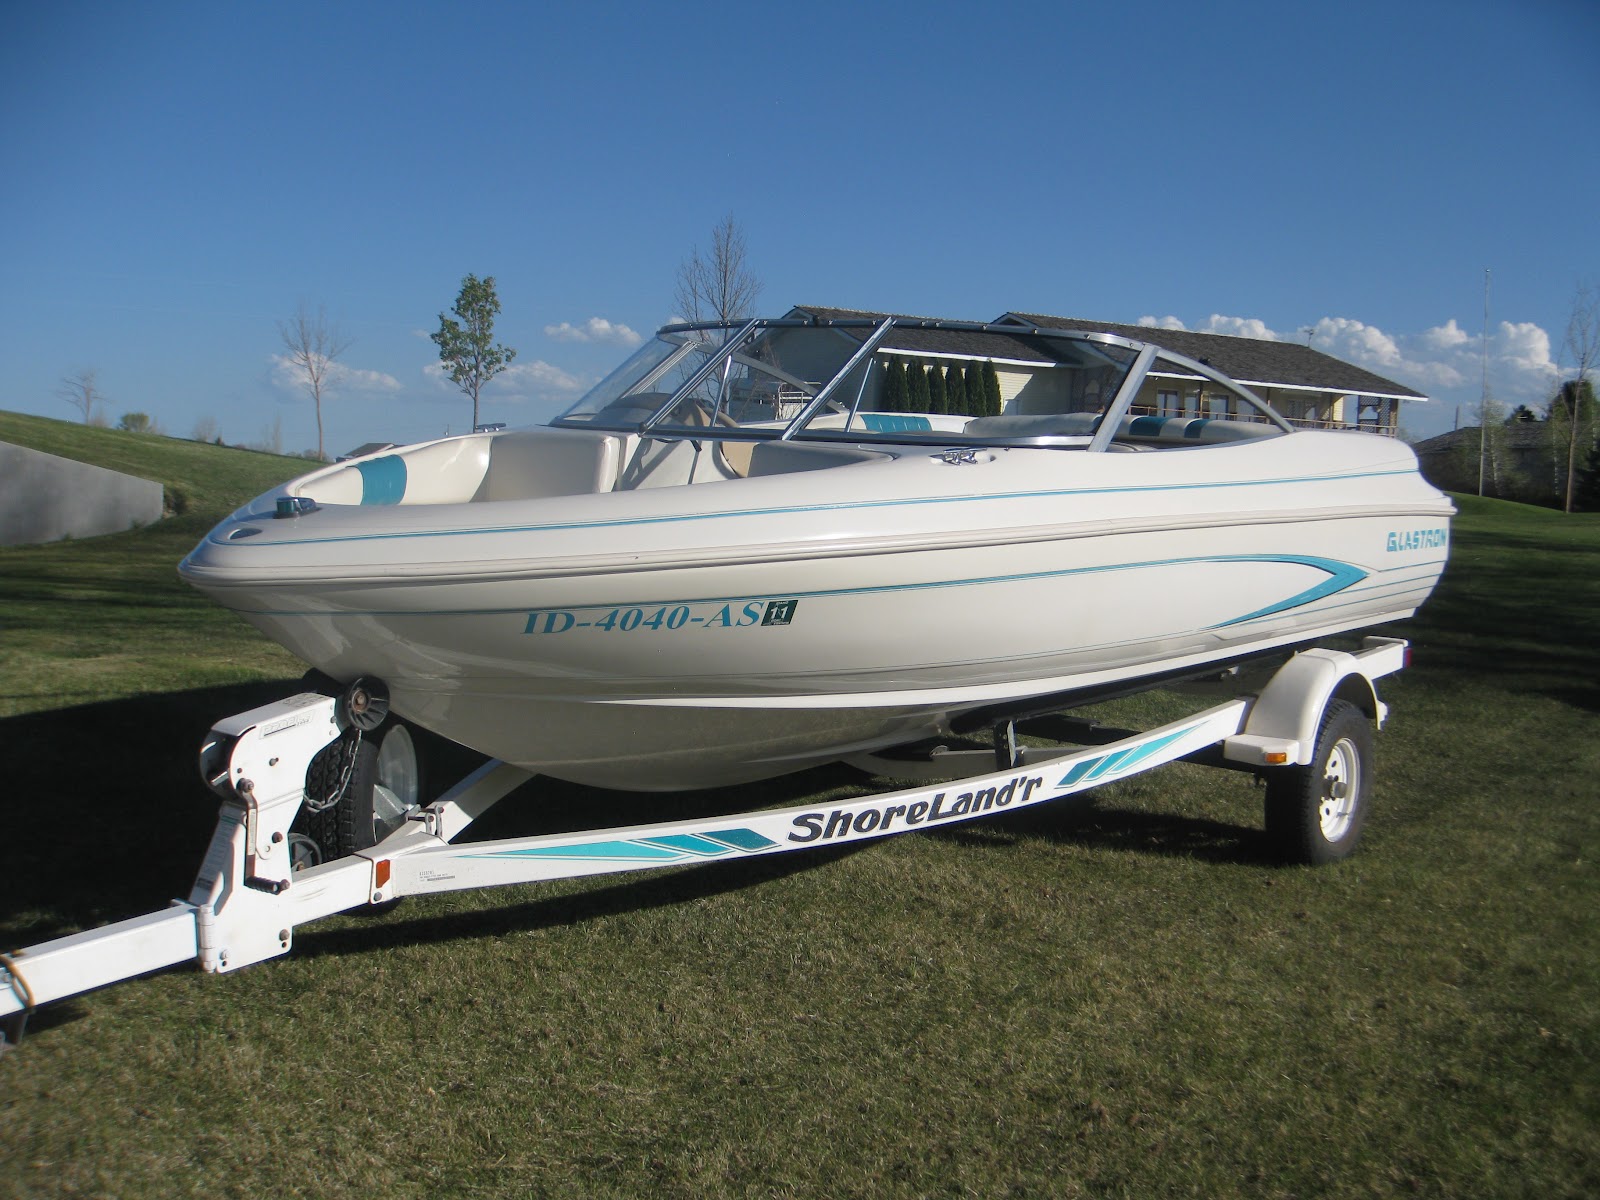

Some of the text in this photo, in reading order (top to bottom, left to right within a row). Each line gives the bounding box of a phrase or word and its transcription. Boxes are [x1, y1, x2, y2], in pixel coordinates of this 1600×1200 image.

[1386, 528, 1447, 552] GLASTRON
[520, 601, 765, 635] ID-4040-AS
[770, 605, 789, 620] 11
[787, 776, 1044, 843] ShoreLand'r
